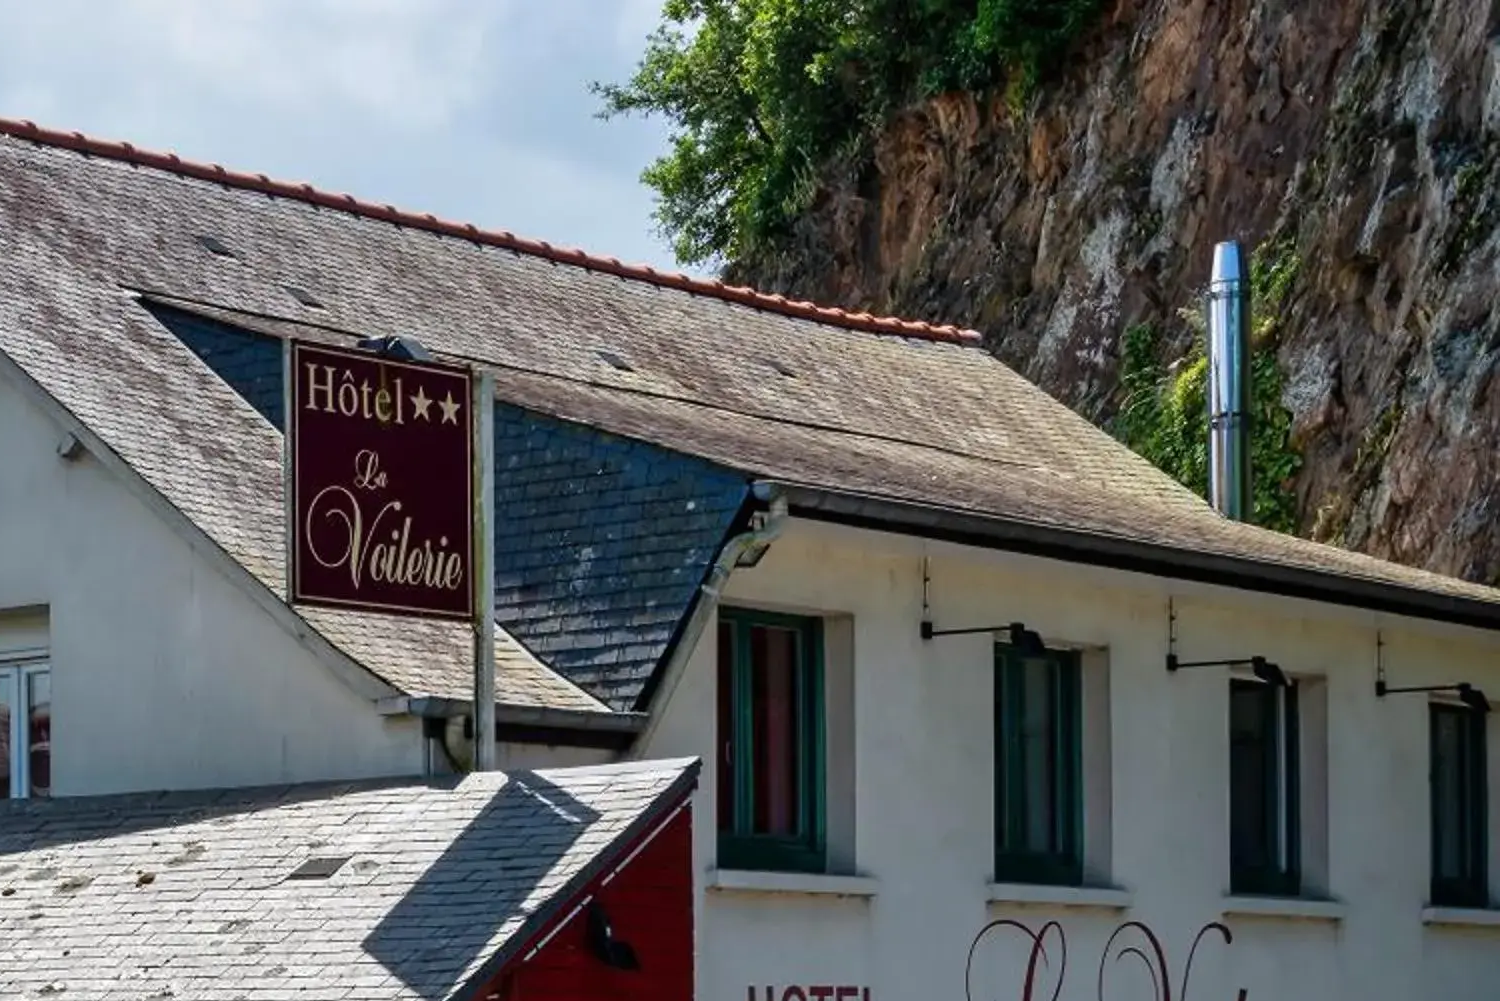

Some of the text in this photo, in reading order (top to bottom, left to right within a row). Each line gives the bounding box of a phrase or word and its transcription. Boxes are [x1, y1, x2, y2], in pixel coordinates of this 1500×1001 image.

[305, 363, 405, 425] Hôtel
[354, 449, 388, 490] La
[307, 485, 463, 590] Voilerie
